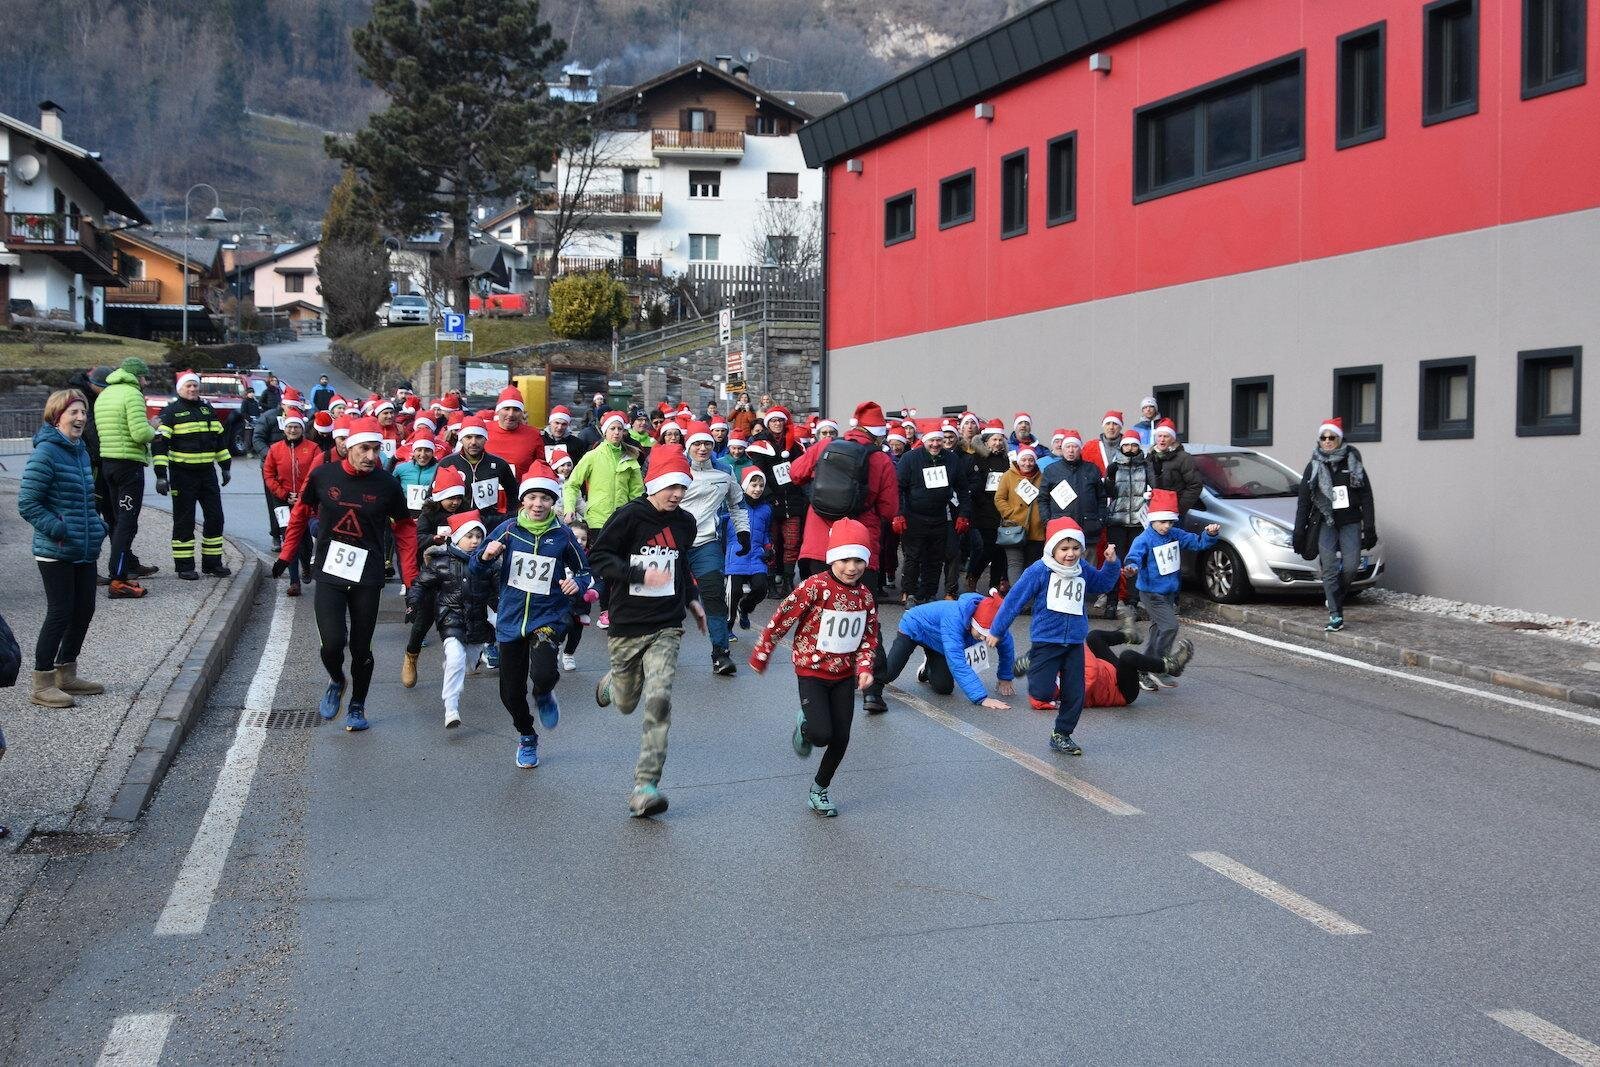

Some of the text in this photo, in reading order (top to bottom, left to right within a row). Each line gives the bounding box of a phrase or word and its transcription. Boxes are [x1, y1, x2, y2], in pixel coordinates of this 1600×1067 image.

[448, 319, 461, 332] P
[927, 468, 945, 481] 111
[413, 488, 428, 501] 70
[478, 483, 494, 499] 58
[1020, 482, 1036, 498] 107
[335, 548, 356, 567] 59
[640, 545, 679, 560] adidas
[1159, 546, 1178, 564] 147
[515, 558, 551, 582] 132
[1053, 579, 1083, 602] 148
[826, 616, 861, 639] 100
